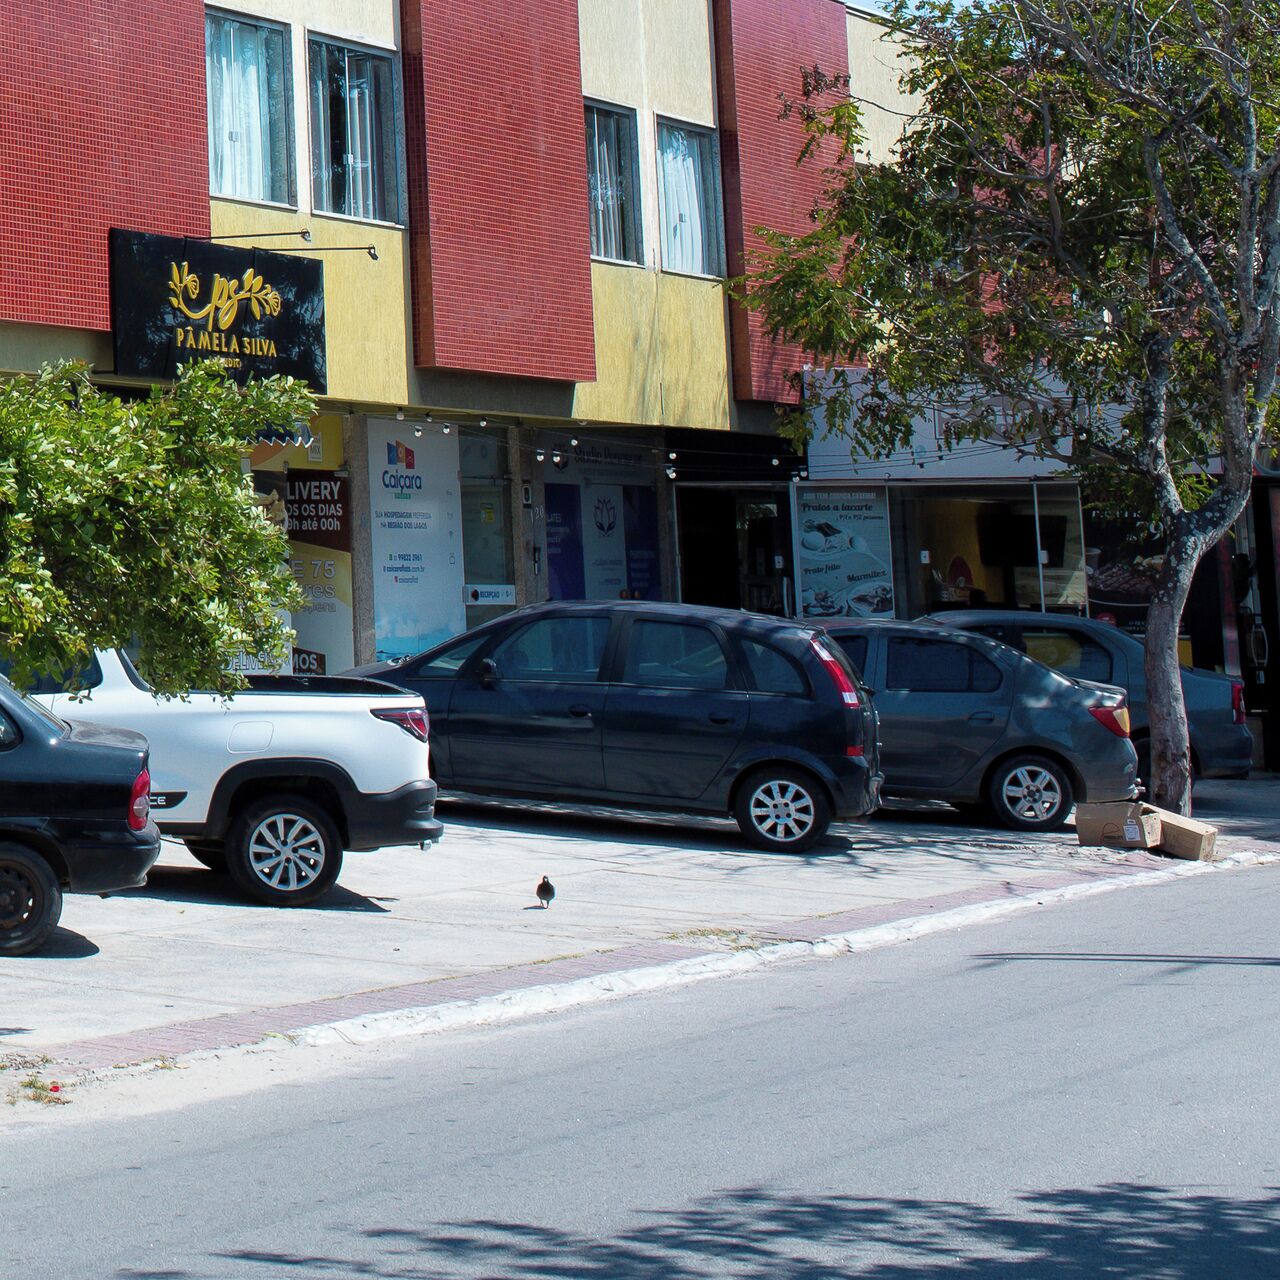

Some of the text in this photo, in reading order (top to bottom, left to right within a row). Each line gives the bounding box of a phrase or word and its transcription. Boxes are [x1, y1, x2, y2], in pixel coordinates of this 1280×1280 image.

[176, 326, 277, 358] PÂMELA SILVA
[382, 469, 422, 494] Caiçara
[301, 504, 316, 516] OS
[318, 504, 343, 517] DIAS
[801, 502, 830, 512] Pratos
[384, 510, 412, 519] HOSPEDAGEM
[302, 517, 318, 530] até
[320, 519, 341, 531] 00h
[311, 560, 336, 579] 75
[802, 567, 823, 575] Prato
